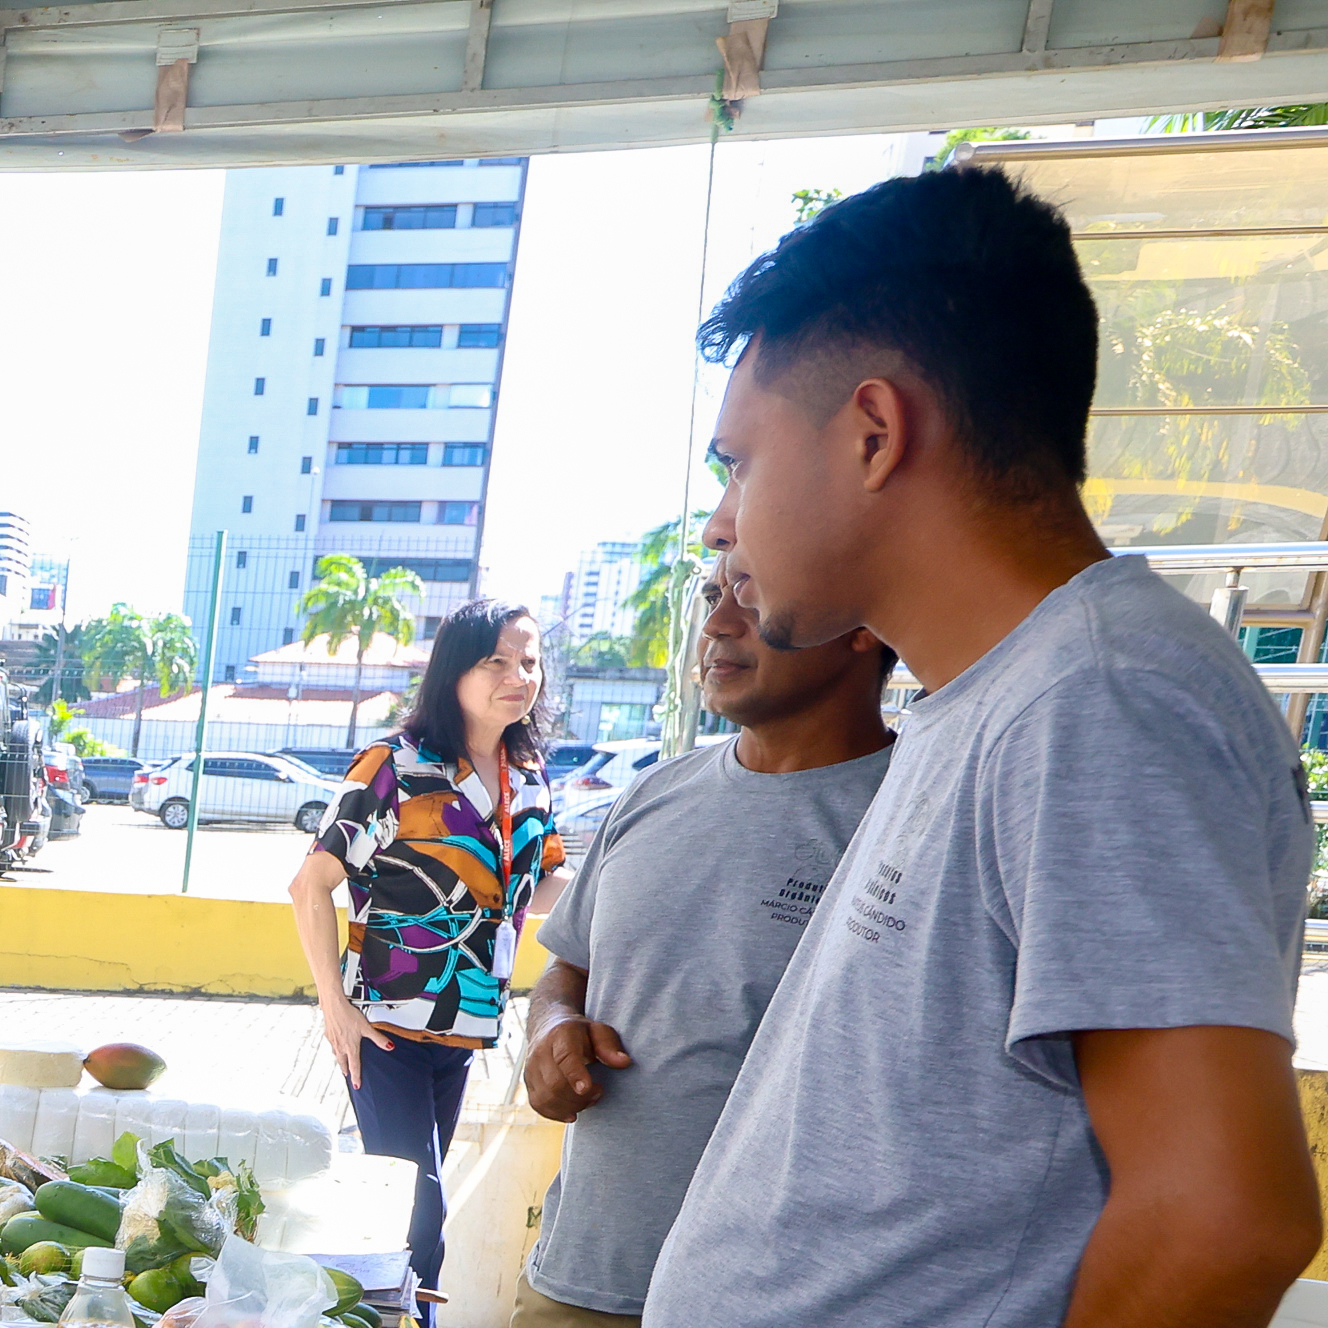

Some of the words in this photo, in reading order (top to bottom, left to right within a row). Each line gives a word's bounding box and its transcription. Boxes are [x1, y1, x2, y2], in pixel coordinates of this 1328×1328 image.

[503, 792, 511, 814] ALECE
[503, 839, 511, 861] ALECE
[786, 877, 828, 893] Produt
[760, 899, 798, 913] MÁRCIO
[770, 912, 809, 926] PRODUT
